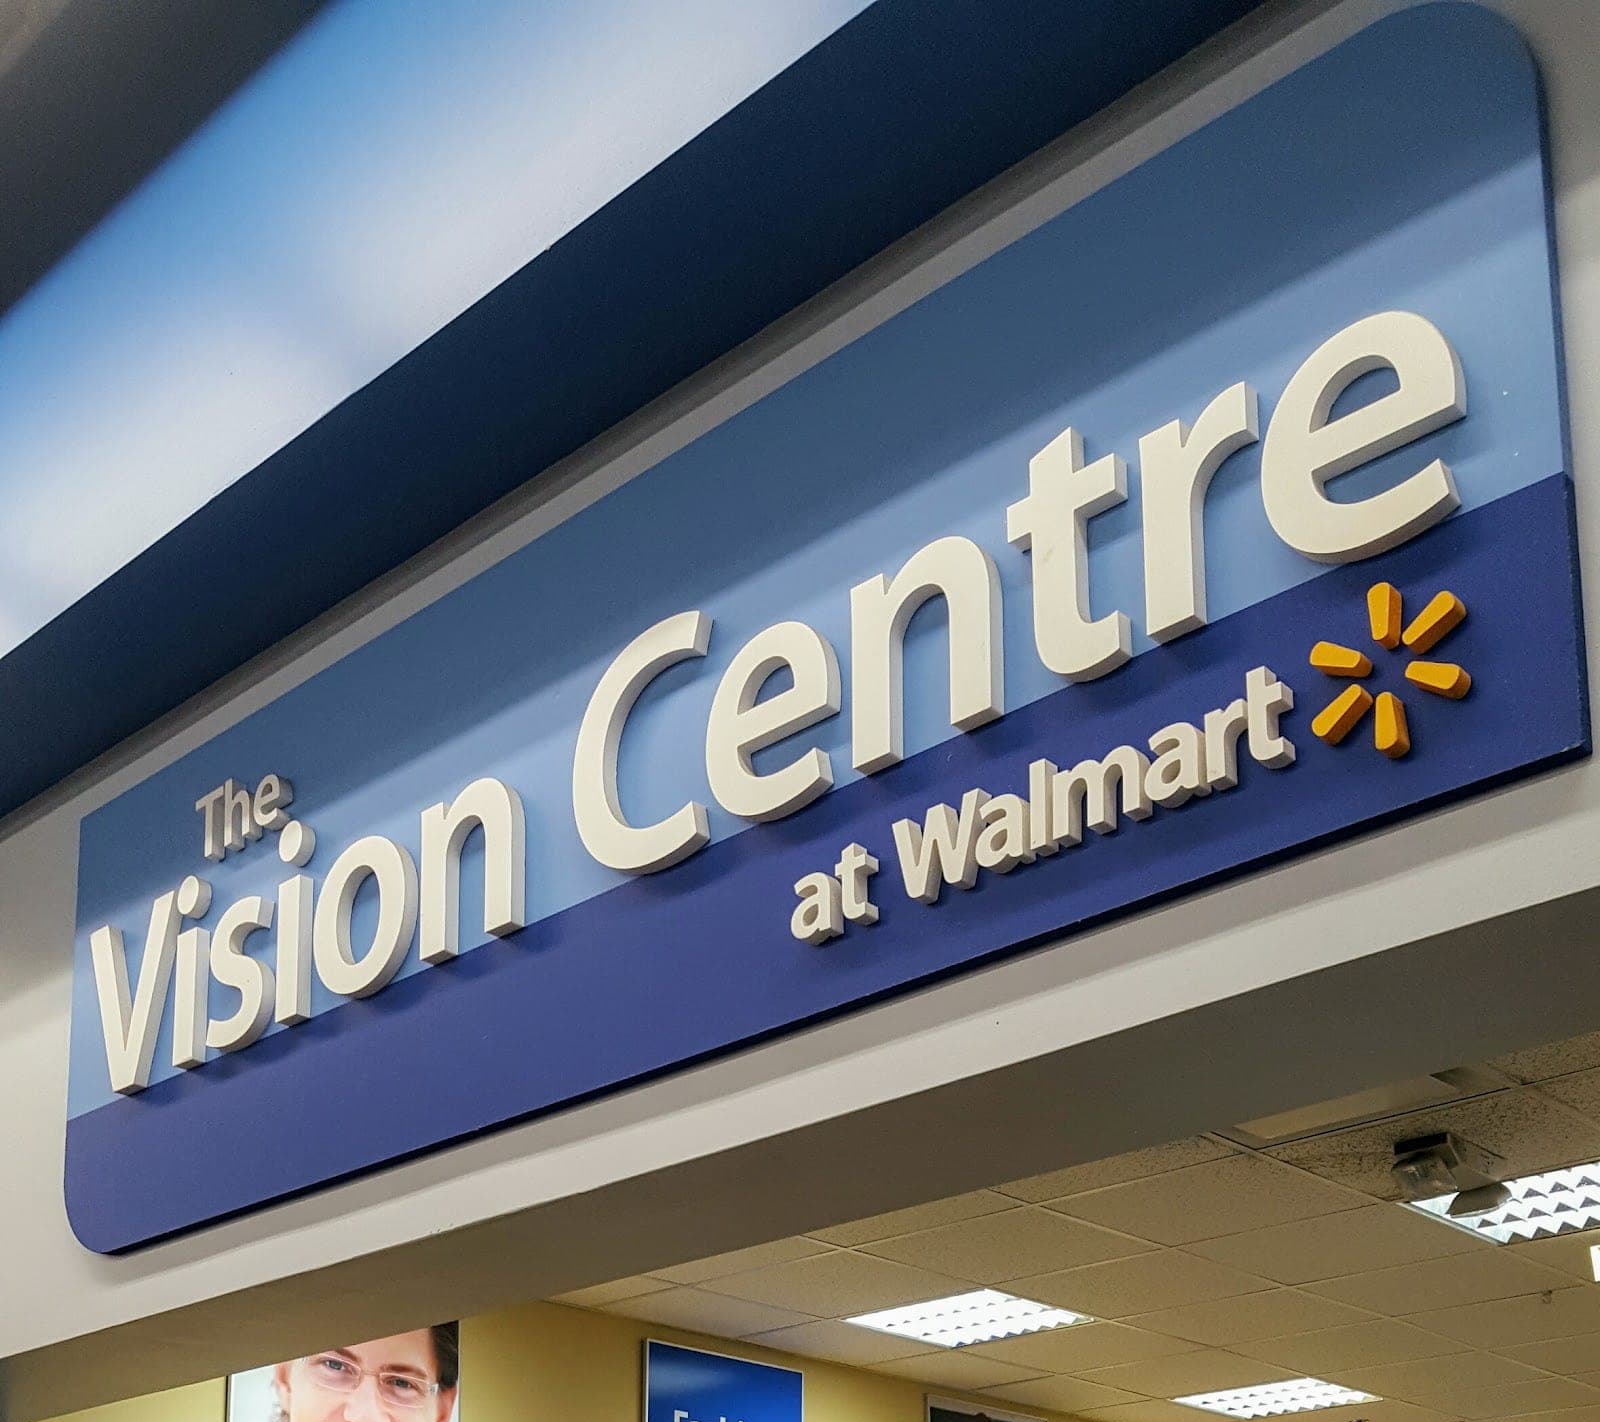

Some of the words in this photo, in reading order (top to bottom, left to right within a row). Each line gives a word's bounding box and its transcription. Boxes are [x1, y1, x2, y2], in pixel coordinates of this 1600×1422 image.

[90, 776, 526, 1096] Vision
[572, 311, 1467, 875] Centre
[195, 770, 294, 861] The
[790, 842, 880, 945] at
[893, 665, 1296, 904] Walmart
